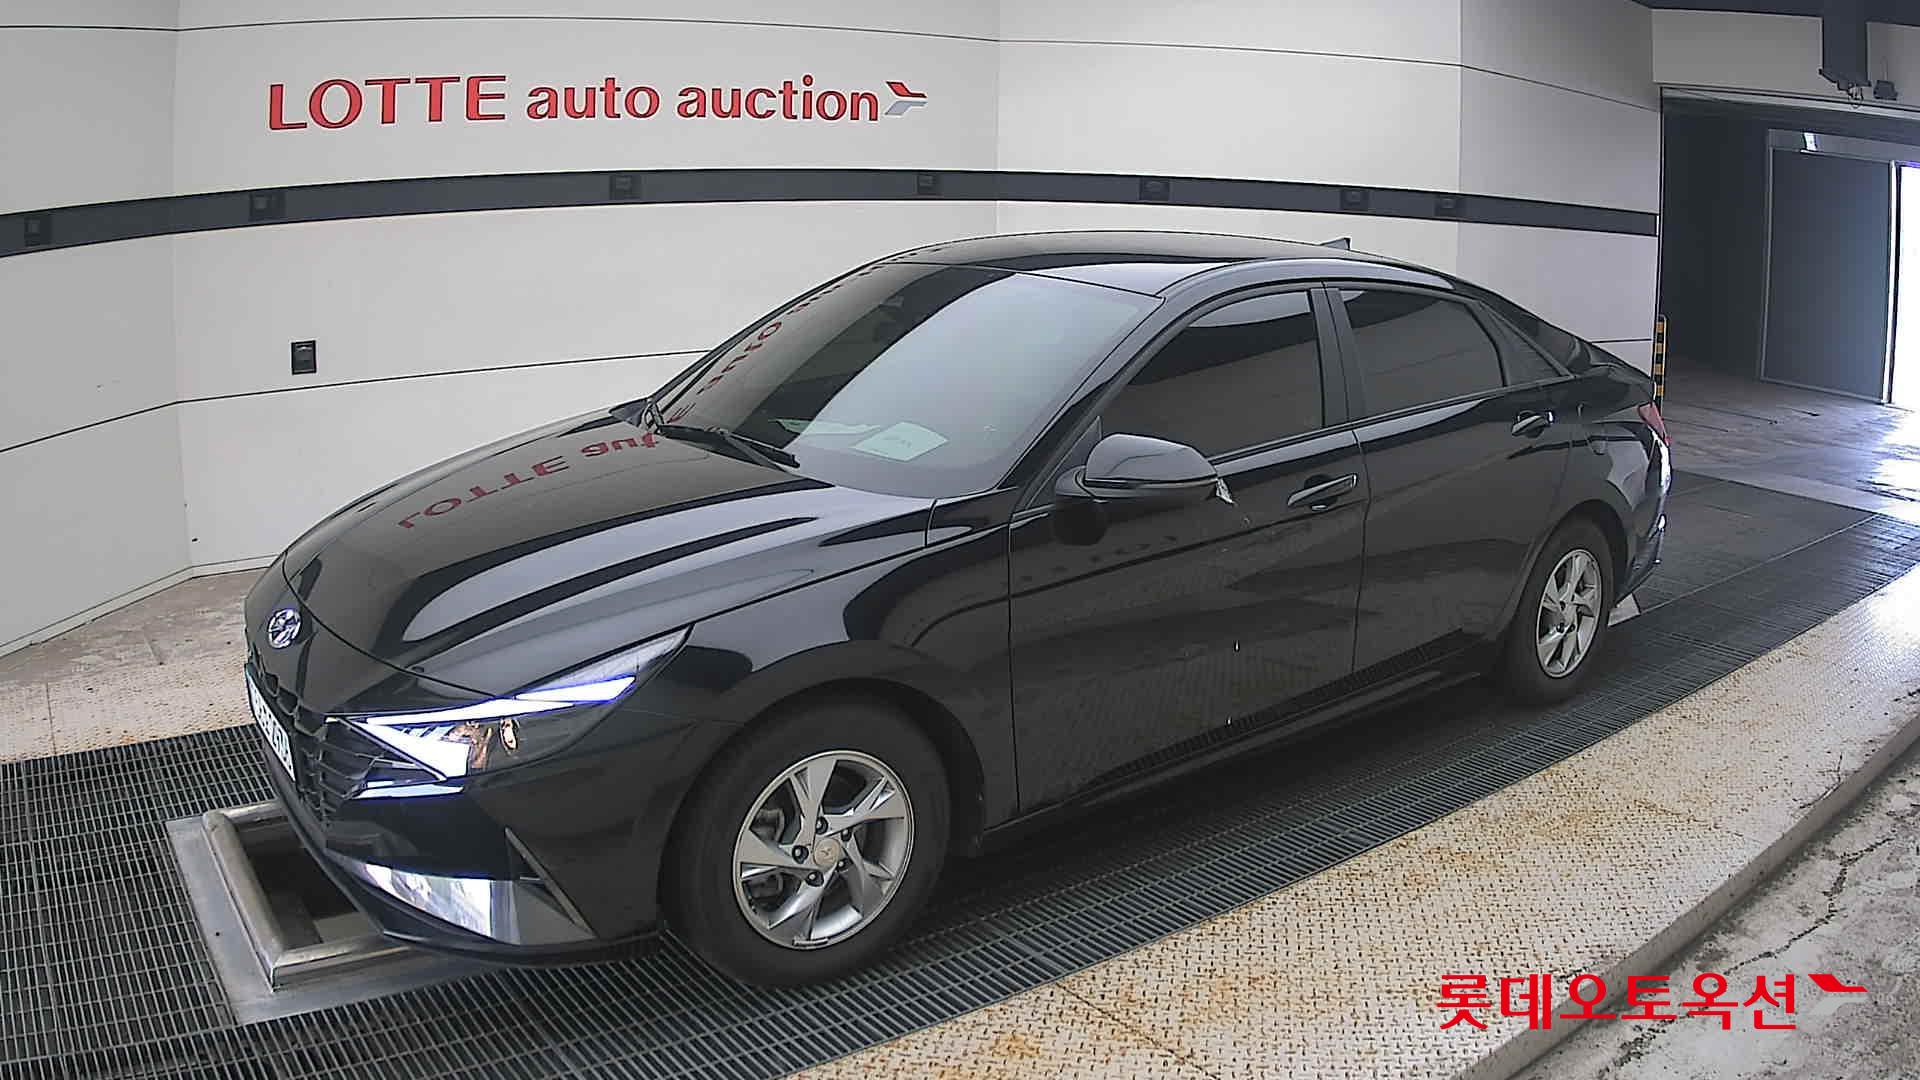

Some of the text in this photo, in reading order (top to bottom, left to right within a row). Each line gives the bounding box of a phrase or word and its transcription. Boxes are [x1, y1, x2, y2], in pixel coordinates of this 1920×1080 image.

[268, 75, 880, 131] LOTTE auto auction
